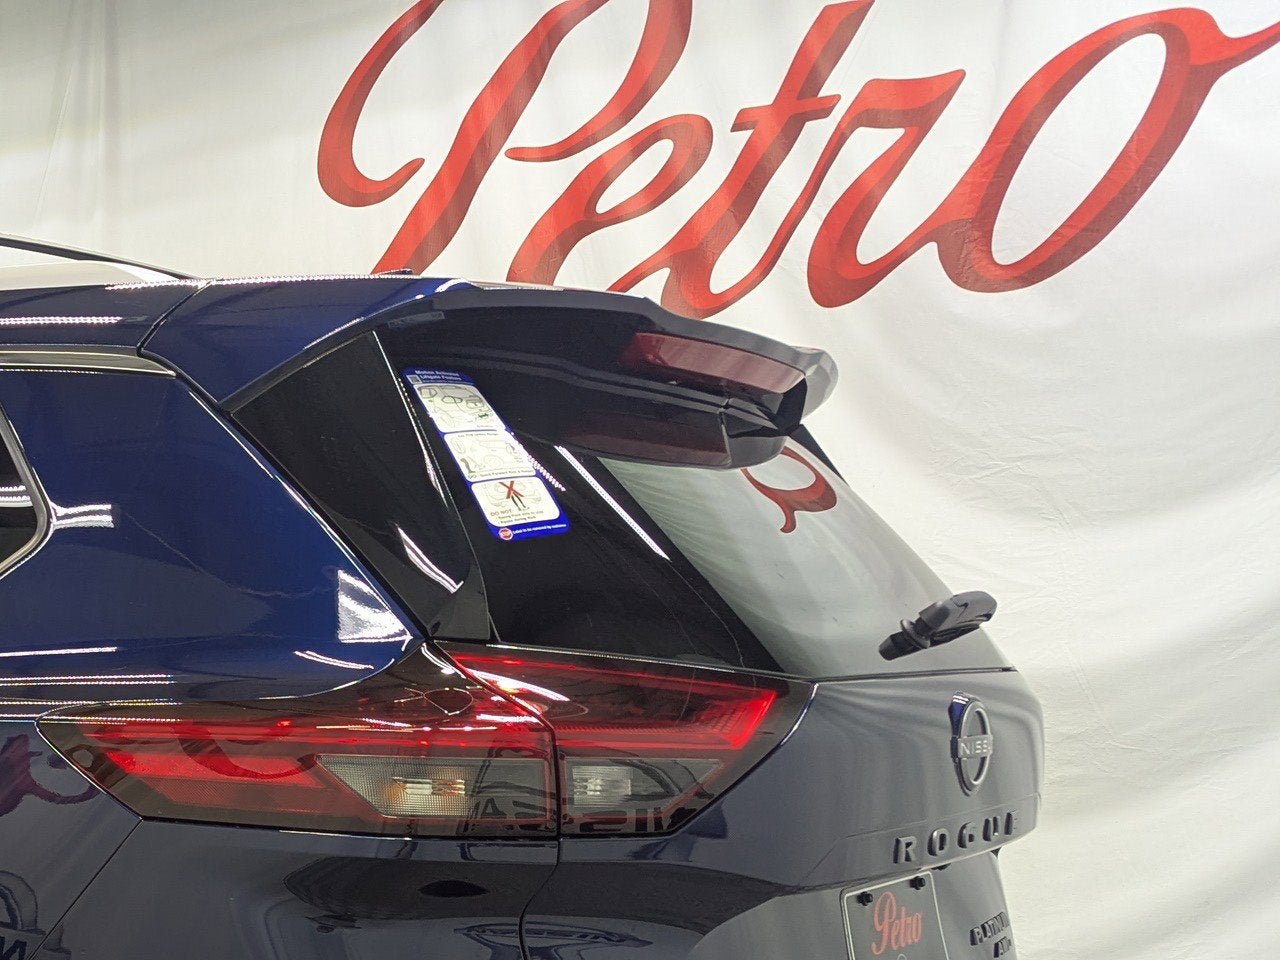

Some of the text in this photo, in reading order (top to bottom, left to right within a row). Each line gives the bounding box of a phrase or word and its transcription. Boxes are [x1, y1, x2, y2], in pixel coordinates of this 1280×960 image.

[317, 0, 1280, 320] Petro
[893, 809, 1019, 864] ROGUE
[871, 890, 924, 957] Petro
